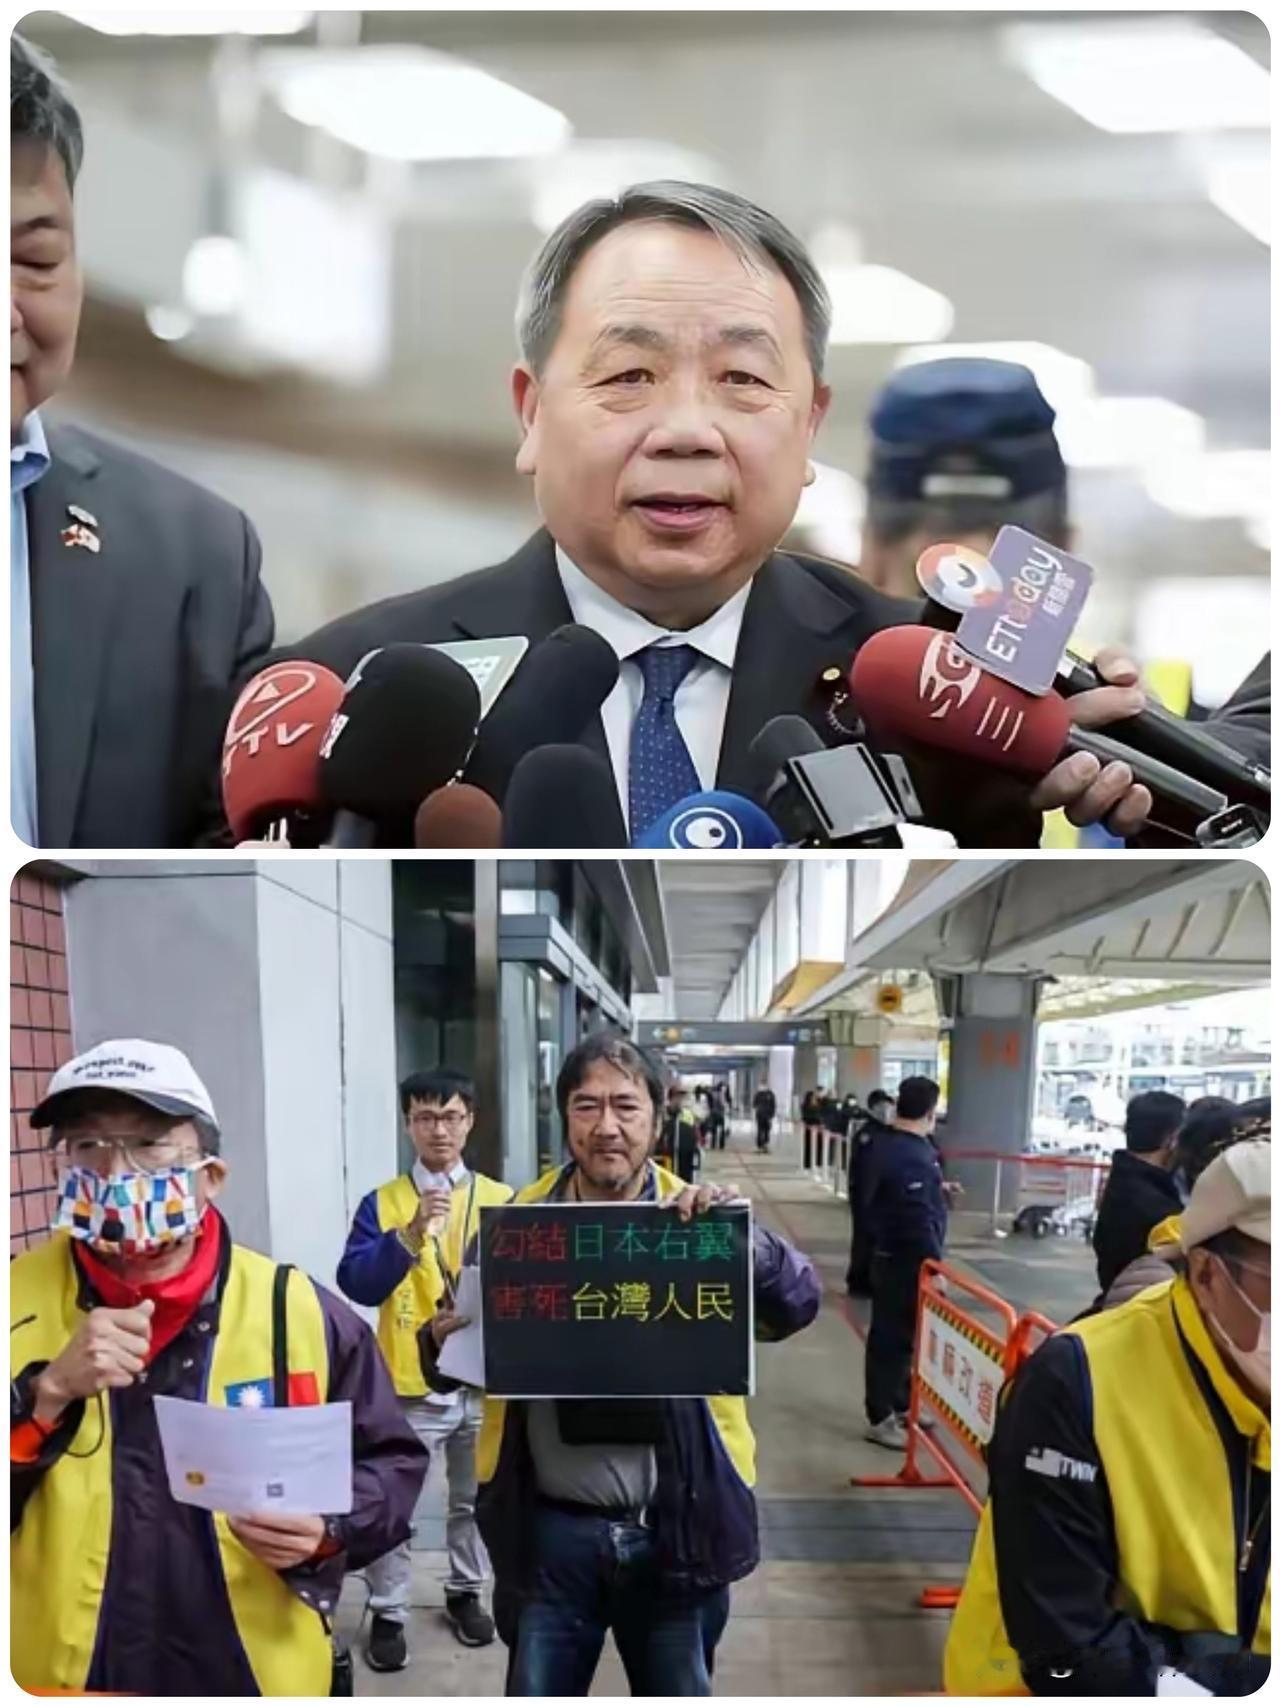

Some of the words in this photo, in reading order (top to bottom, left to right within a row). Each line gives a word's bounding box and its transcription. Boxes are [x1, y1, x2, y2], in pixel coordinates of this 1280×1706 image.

[490, 1222, 734, 1262] 勾結日本右翼
[490, 1282, 734, 1322] 害死台灣人民
